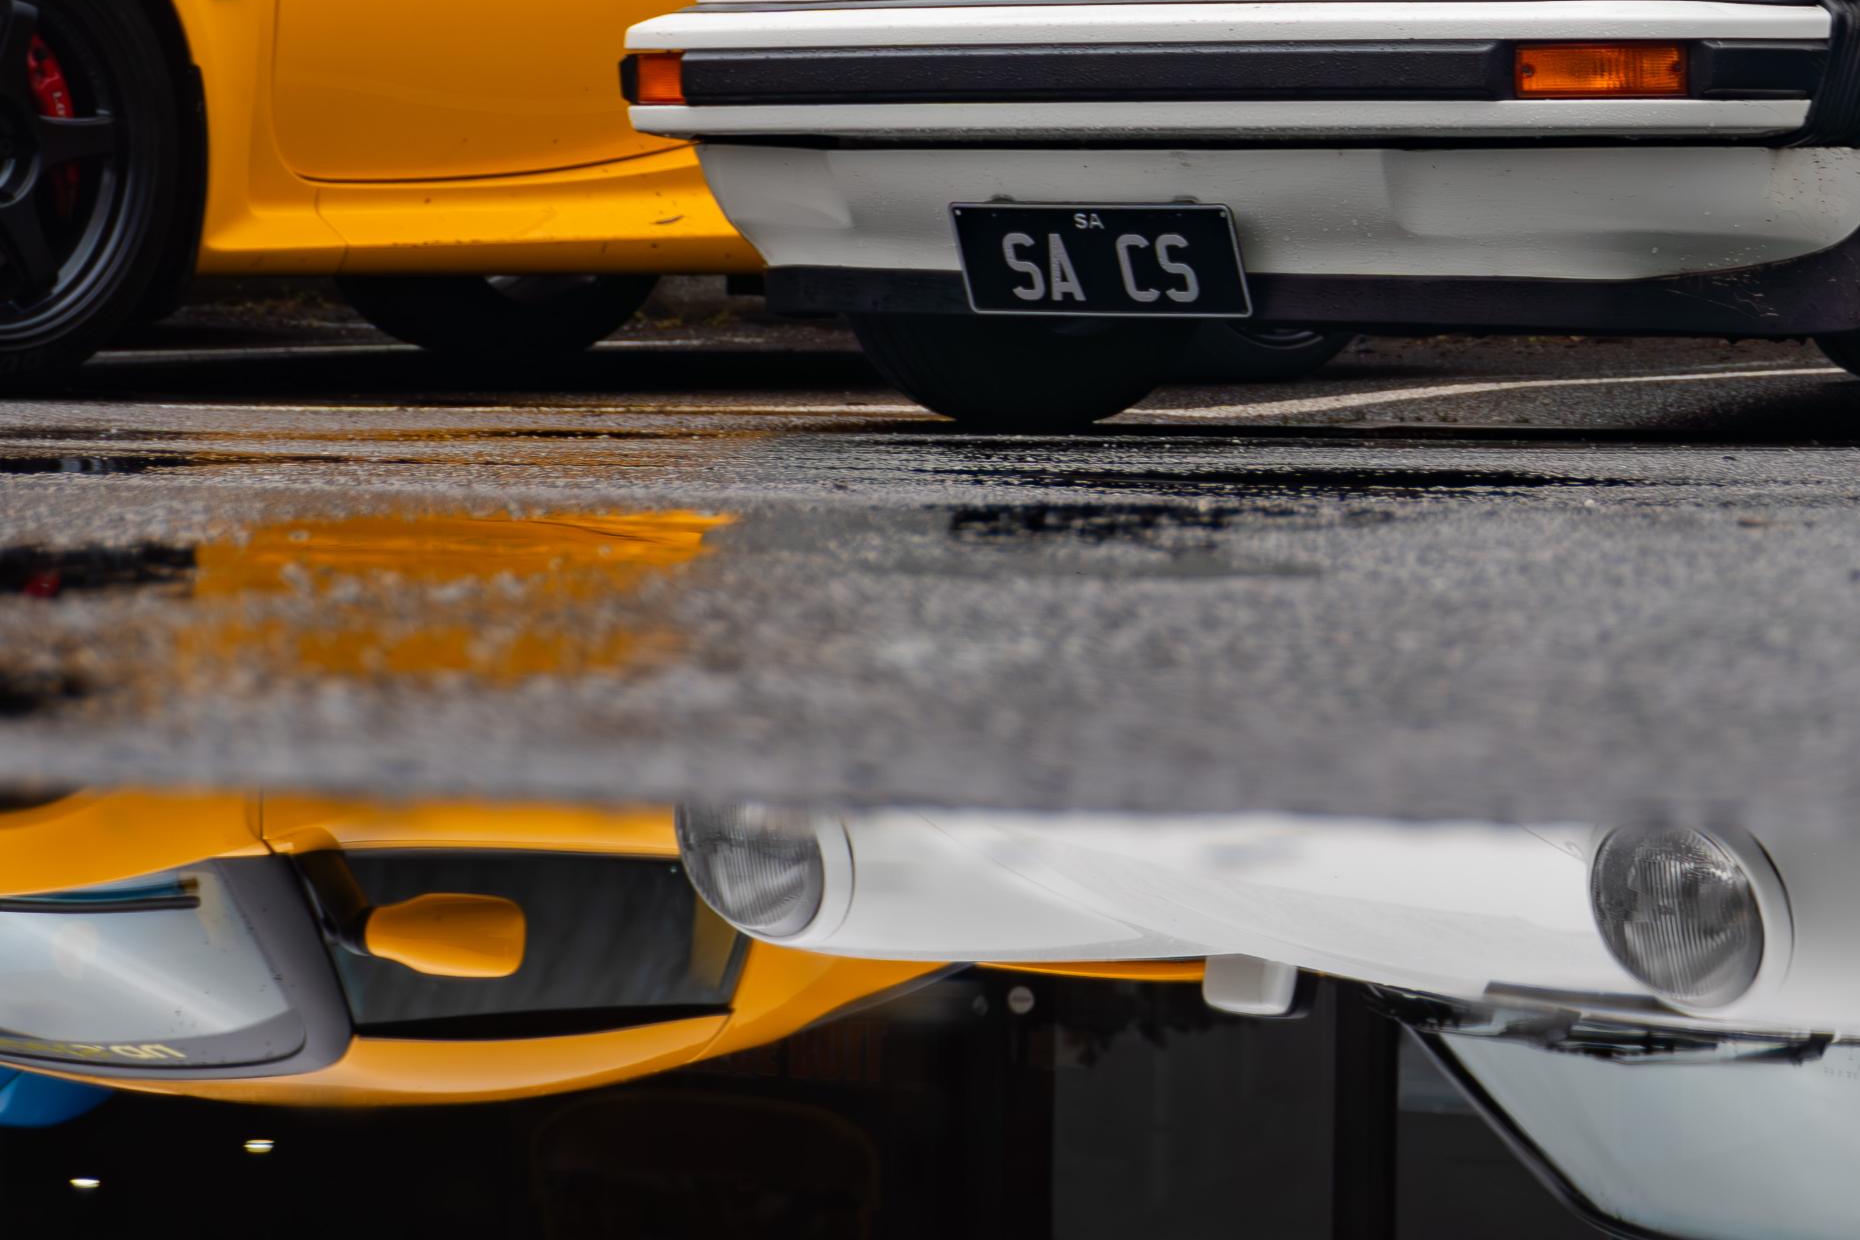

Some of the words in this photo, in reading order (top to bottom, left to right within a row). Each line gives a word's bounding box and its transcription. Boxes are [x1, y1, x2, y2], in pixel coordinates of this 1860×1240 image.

[1074, 213, 1105, 230] SA
[1001, 231, 1087, 302] SA
[1115, 232, 1200, 303] CS
